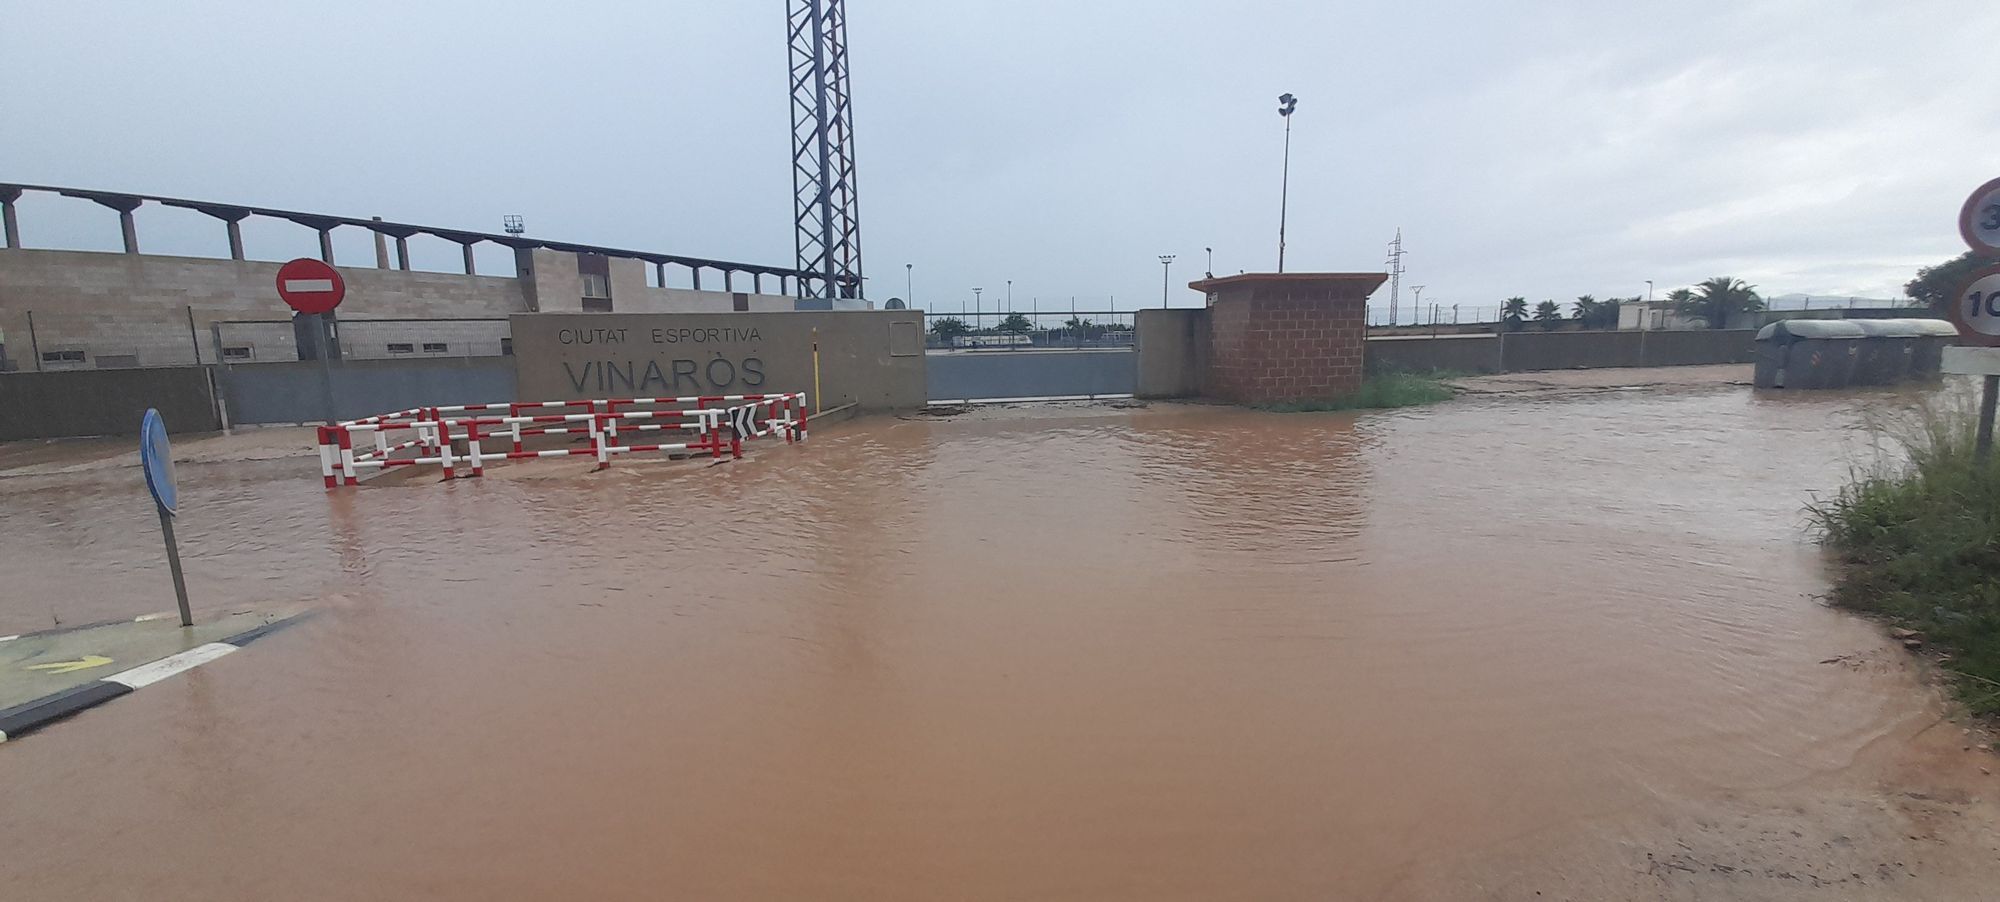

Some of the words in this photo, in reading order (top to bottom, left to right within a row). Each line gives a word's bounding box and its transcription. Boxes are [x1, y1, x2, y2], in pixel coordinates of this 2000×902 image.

[558, 328, 627, 344] CIUTAT
[652, 327, 762, 344] ESPORTIVA
[563, 353, 766, 393] VINARÒS
